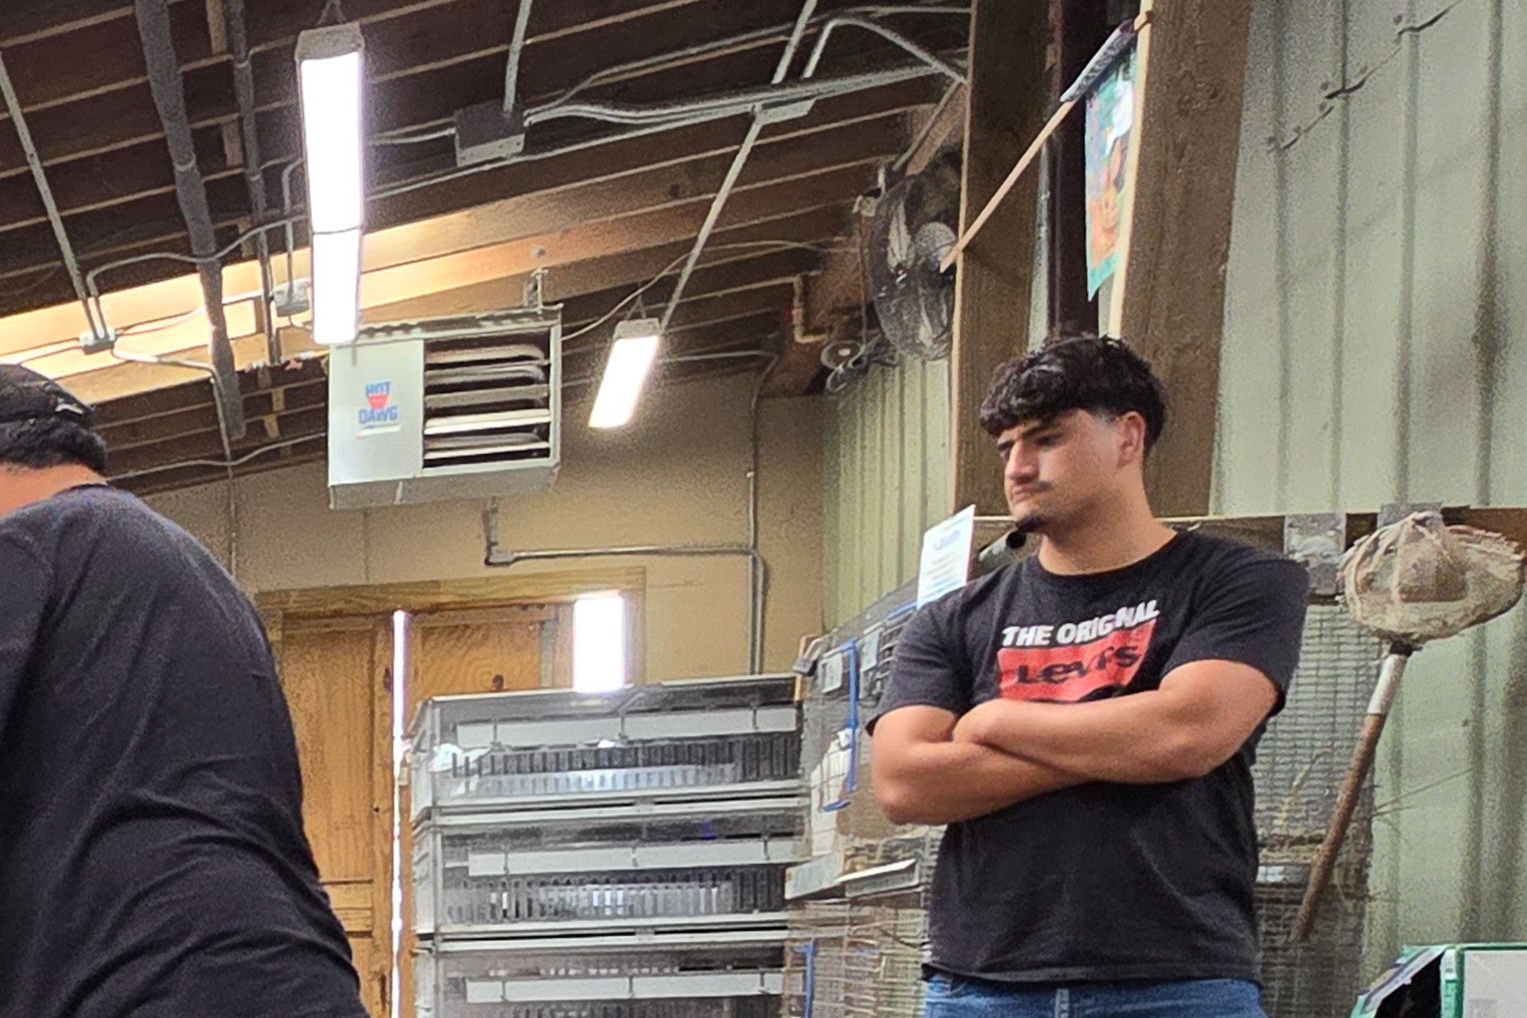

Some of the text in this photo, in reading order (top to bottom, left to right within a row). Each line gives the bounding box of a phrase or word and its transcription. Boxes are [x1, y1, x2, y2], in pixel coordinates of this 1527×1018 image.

[365, 380, 392, 397] HOT
[1002, 600, 1160, 647] THE ORIGNAL
